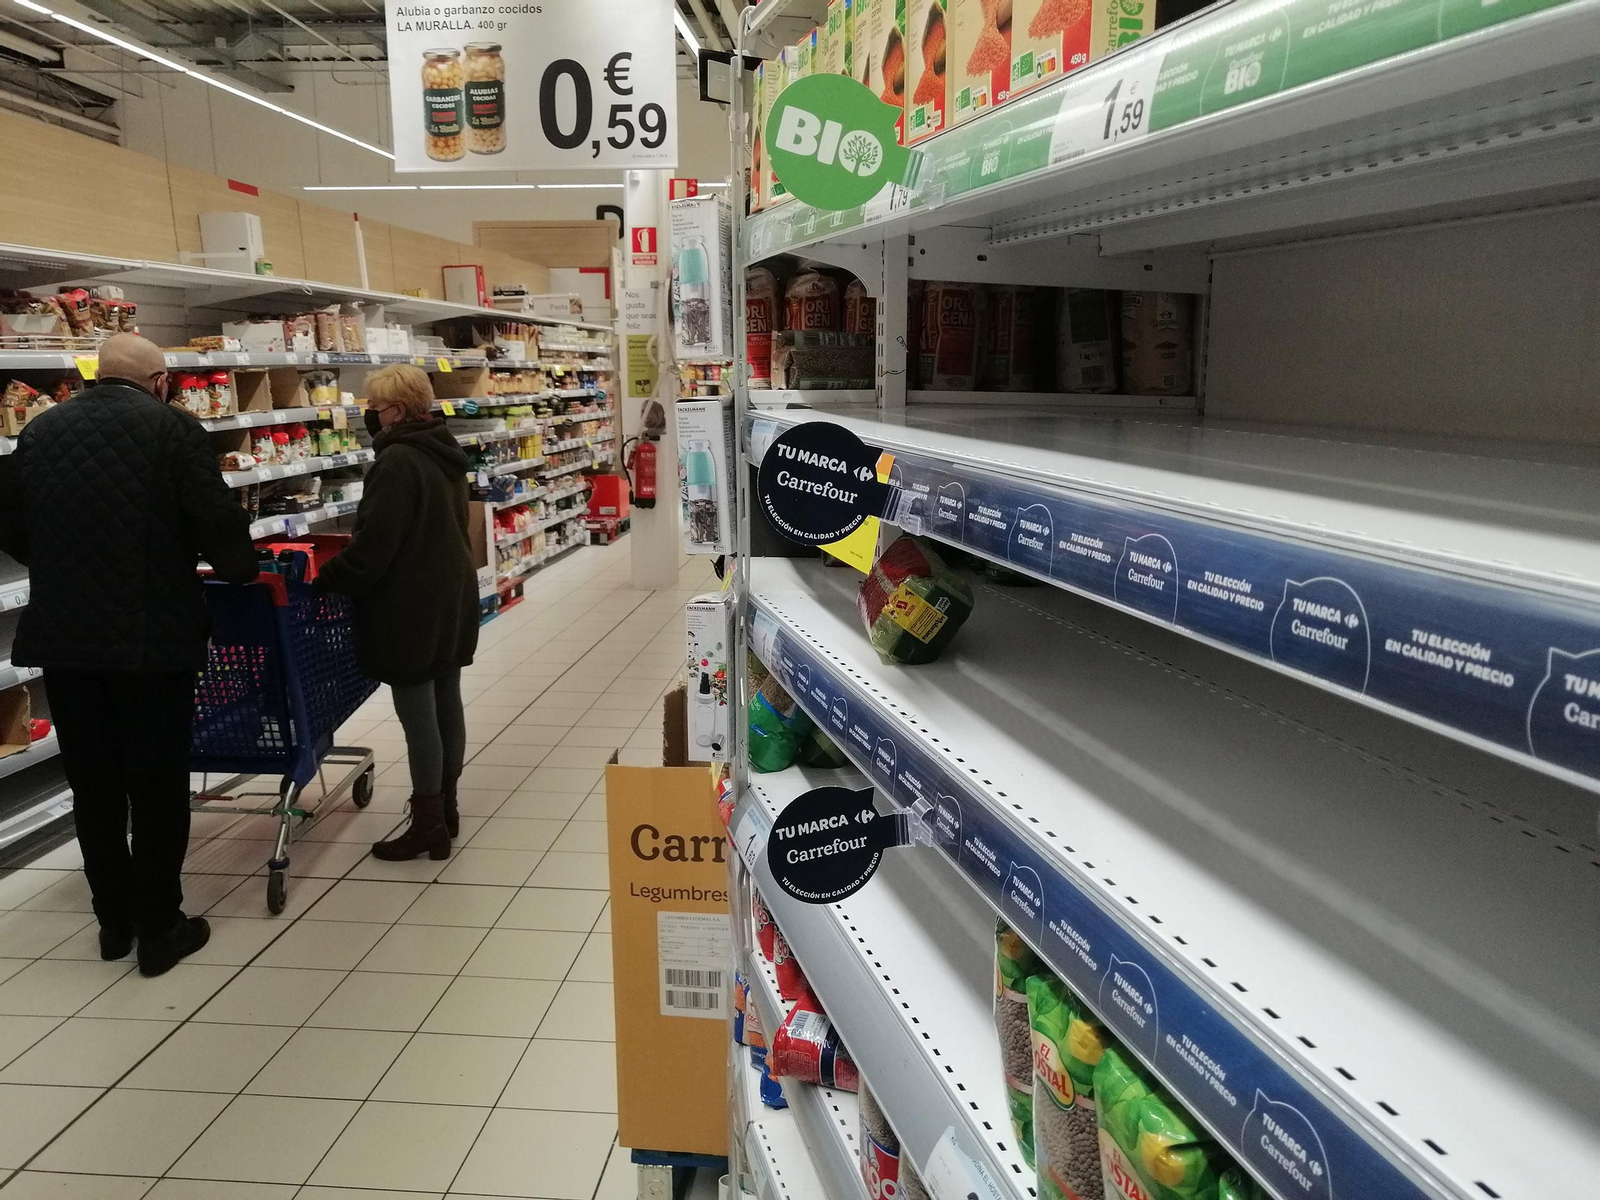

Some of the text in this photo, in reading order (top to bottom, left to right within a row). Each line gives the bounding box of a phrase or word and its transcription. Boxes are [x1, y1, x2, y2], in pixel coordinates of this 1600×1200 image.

[396, 4, 543, 18] Alubia o garbanzo cocidos
[1302, 25, 1318, 39] EN
[1317, 8, 1362, 33] CALIDAD
[397, 20, 507, 32] LA MURALLA. 400 gr
[1225, 32, 1267, 58] TU MARCA
[1229, 51, 1265, 70] Carrefour
[1172, 70, 1199, 87] PRECIO
[1224, 61, 1262, 95] BIO
[470, 87, 499, 95] ALUBIAS
[538, 58, 667, 159] 0,59
[603, 52, 634, 96] €
[1103, 78, 1145, 142] 1,59
[775, 105, 883, 177] BIO
[981, 156, 999, 177] BIO
[549, 303, 568, 311] Pasta
[625, 291, 640, 299] Nos
[626, 302, 646, 310] gusta
[626, 322, 641, 330] feliz
[777, 443, 848, 474] TU MARCA
[764, 493, 772, 505] TU
[777, 470, 858, 505] Carrefour
[938, 507, 958, 522] Carrefour
[944, 497, 957, 508] MARCA
[977, 505, 1002, 519] TU ELECCIÓN
[765, 502, 793, 535] ELECCIÓN
[841, 514, 863, 535] PRECIO
[968, 512, 976, 521] EN
[975, 514, 990, 526] CALIDAD
[992, 518, 1007, 531] PRECIO
[1019, 519, 1043, 535] TU MARCA
[793, 528, 804, 537] EN
[804, 532, 836, 540] CALIDAD
[1017, 533, 1044, 551] Carrefour
[1071, 532, 1104, 549] TU ELECCIÓN
[1059, 541, 1067, 550] EN
[1066, 542, 1089, 558] CALIDAD
[1091, 550, 1112, 564] PRECIO
[1129, 551, 1161, 570] TU MARCA
[1128, 568, 1165, 591] Carrefour
[1204, 571, 1252, 594] TU ELECCIÓN
[1187, 579, 1265, 612] EN CALIDAD Y PRECIO
[1293, 598, 1342, 625] TU MARCA
[1291, 619, 1349, 651] Carrefour
[1411, 629, 1492, 663] TU ELECCIÓN
[1384, 639, 1515, 689] EN CALIDAD Y PRECIO
[1564, 673, 1588, 695] TU
[775, 814, 849, 841] TU MARCA
[938, 805, 955, 825] TU MARCA
[936, 816, 956, 841] Carrefour
[630, 823, 727, 863] Carr
[786, 835, 868, 865] Carrefour
[974, 836, 997, 862] TU ELECCIÓN
[965, 839, 972, 848] EN
[970, 842, 986, 863] CALIDAD
[986, 860, 1001, 878] PRECIO
[781, 876, 790, 887] TU
[788, 883, 820, 899] ELECCIÓN
[831, 879, 860, 898] CALIDAD
[863, 851, 880, 878] PRECIO
[630, 882, 728, 903] Legumbres
[1013, 875, 1034, 902] TU MARCA
[1011, 889, 1036, 920] Carrefour
[1049, 921, 1057, 931] EN
[1056, 927, 1076, 951] CALIDAD
[1078, 949, 1098, 972] PRECIO
[1060, 919, 1091, 953] TU ELECCIÓN
[1114, 972, 1144, 1006] TU MARCA
[1112, 989, 1147, 1029] Carrefour
[1040, 1043, 1051, 1061] EL
[1182, 1034, 1227, 1082] TU ELECCIÓN
[1034, 1049, 1070, 1099] OSTAL
[1166, 1033, 1177, 1049] EN
[1175, 1041, 1206, 1077] CALIDAD
[1209, 1077, 1238, 1107] PRECIO
[1262, 1112, 1308, 1164] TU MARCA
[1260, 1134, 1313, 1193] Carrefour
[983, 1174, 989, 1186] EL
